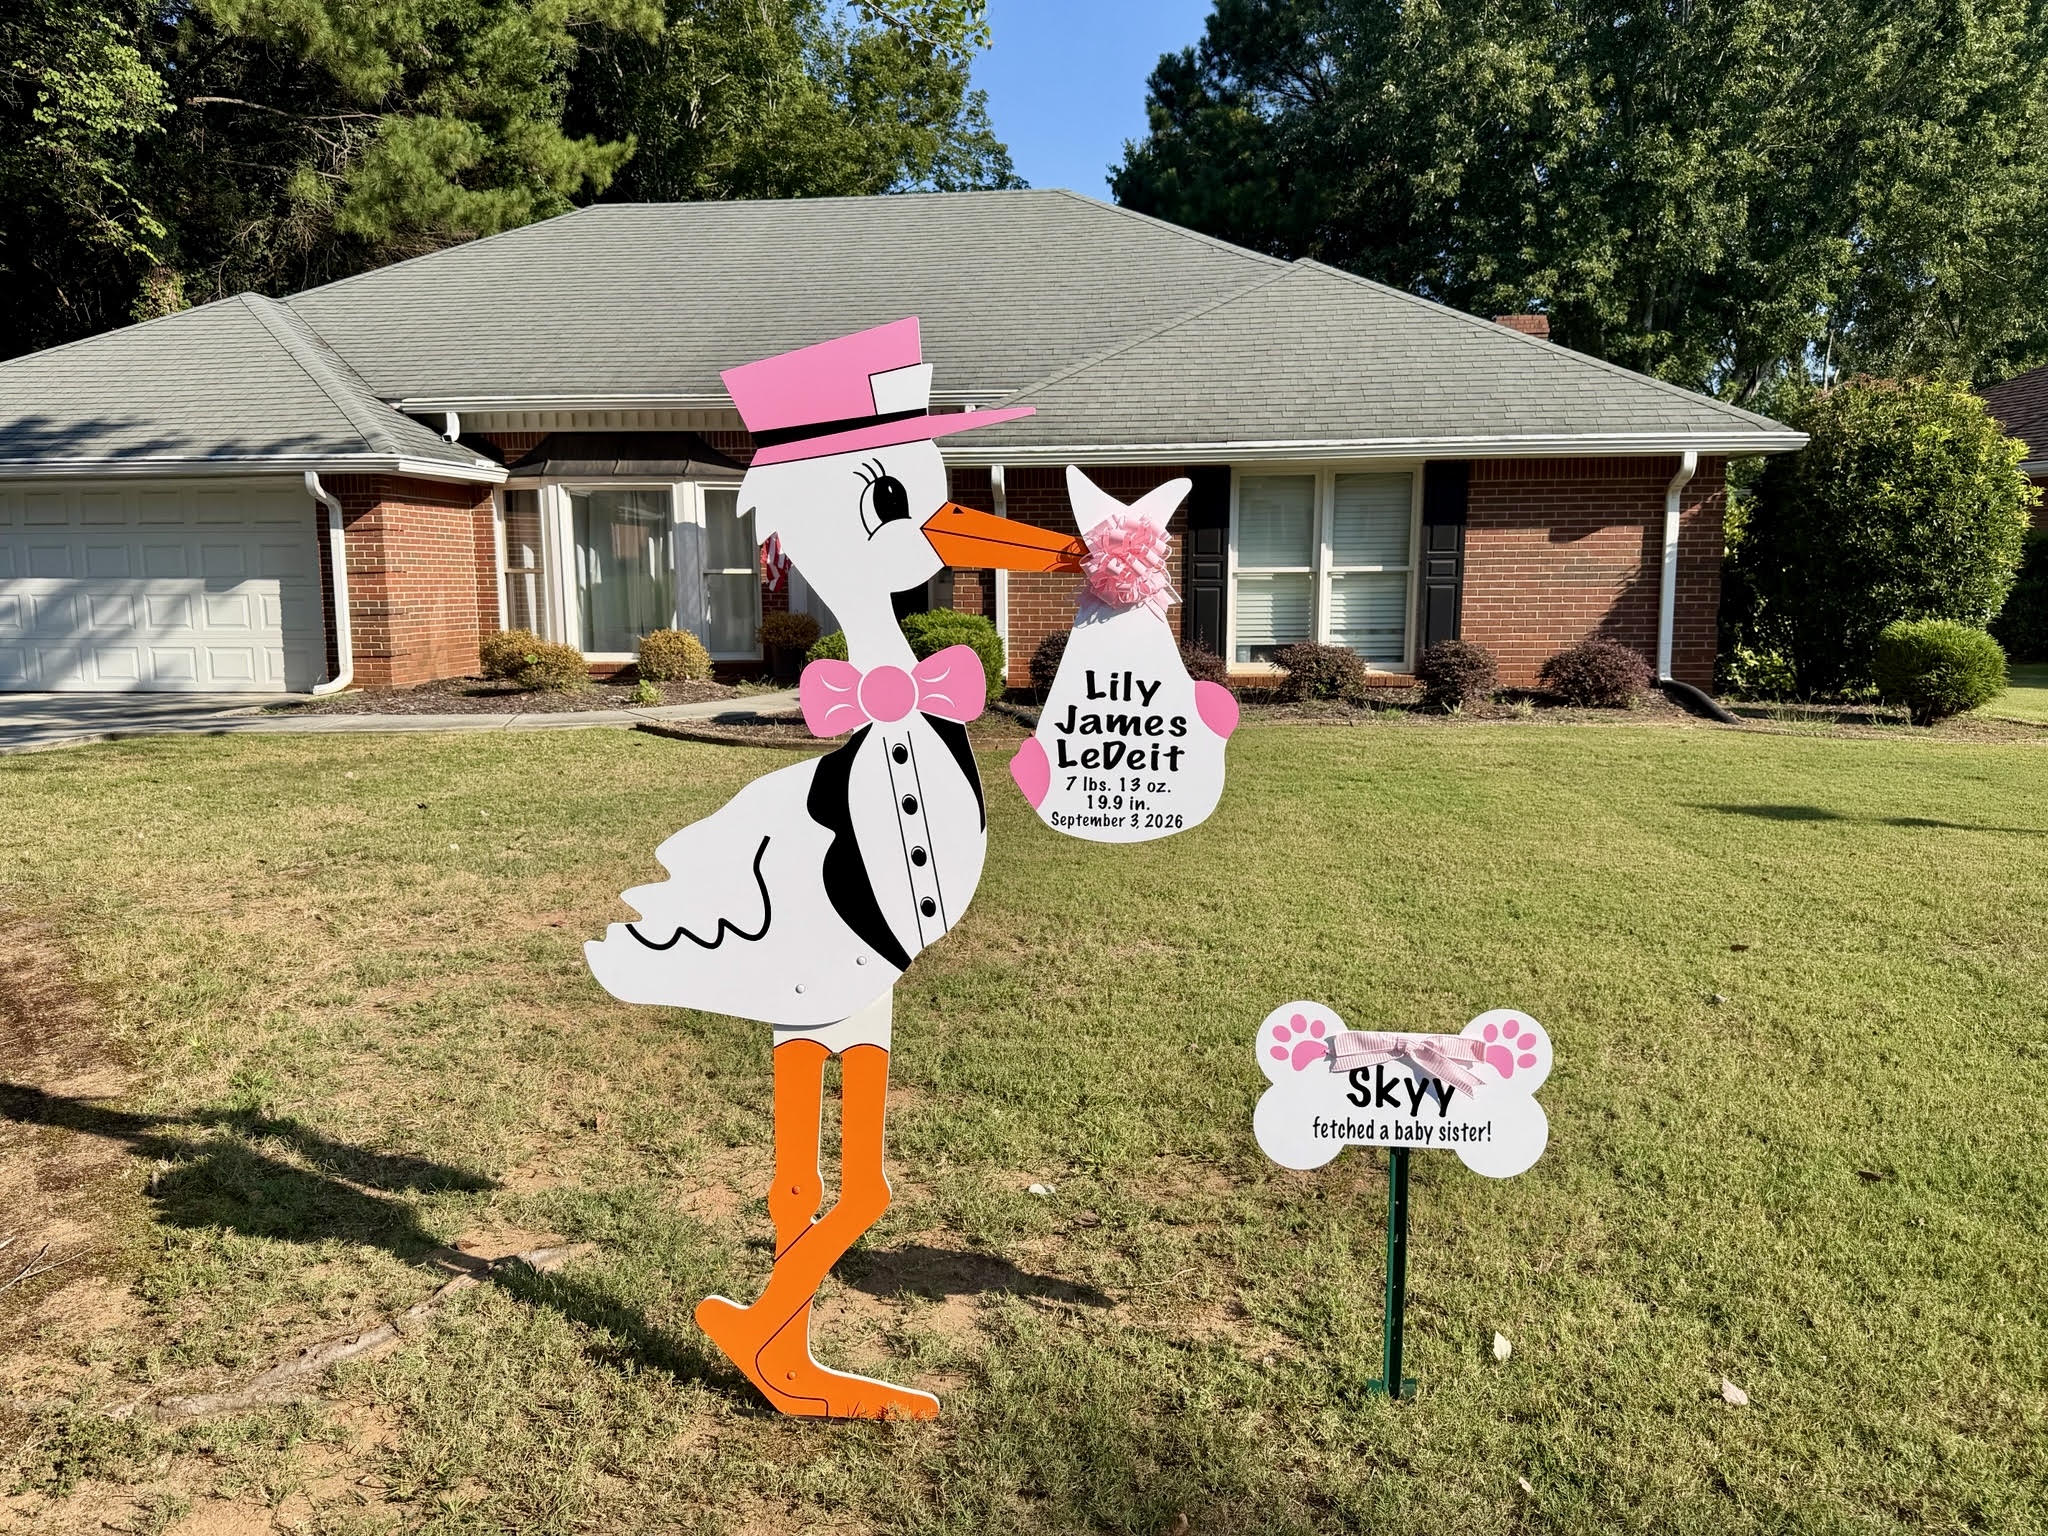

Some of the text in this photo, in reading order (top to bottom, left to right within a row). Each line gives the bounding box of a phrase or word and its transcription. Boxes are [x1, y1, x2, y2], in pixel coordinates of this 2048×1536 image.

[1086, 670, 1161, 707] Lily
[1054, 704, 1187, 737] James
[1056, 738, 1186, 772] LeDeit
[1066, 776, 1171, 793] 7 lbs. 13 oz.
[1088, 795, 1150, 811] 19.9 in.
[1051, 811, 1183, 830] September 3, 2026
[1346, 1064, 1456, 1118] Skyy
[1313, 1116, 1491, 1145] fetched a baby sister!
